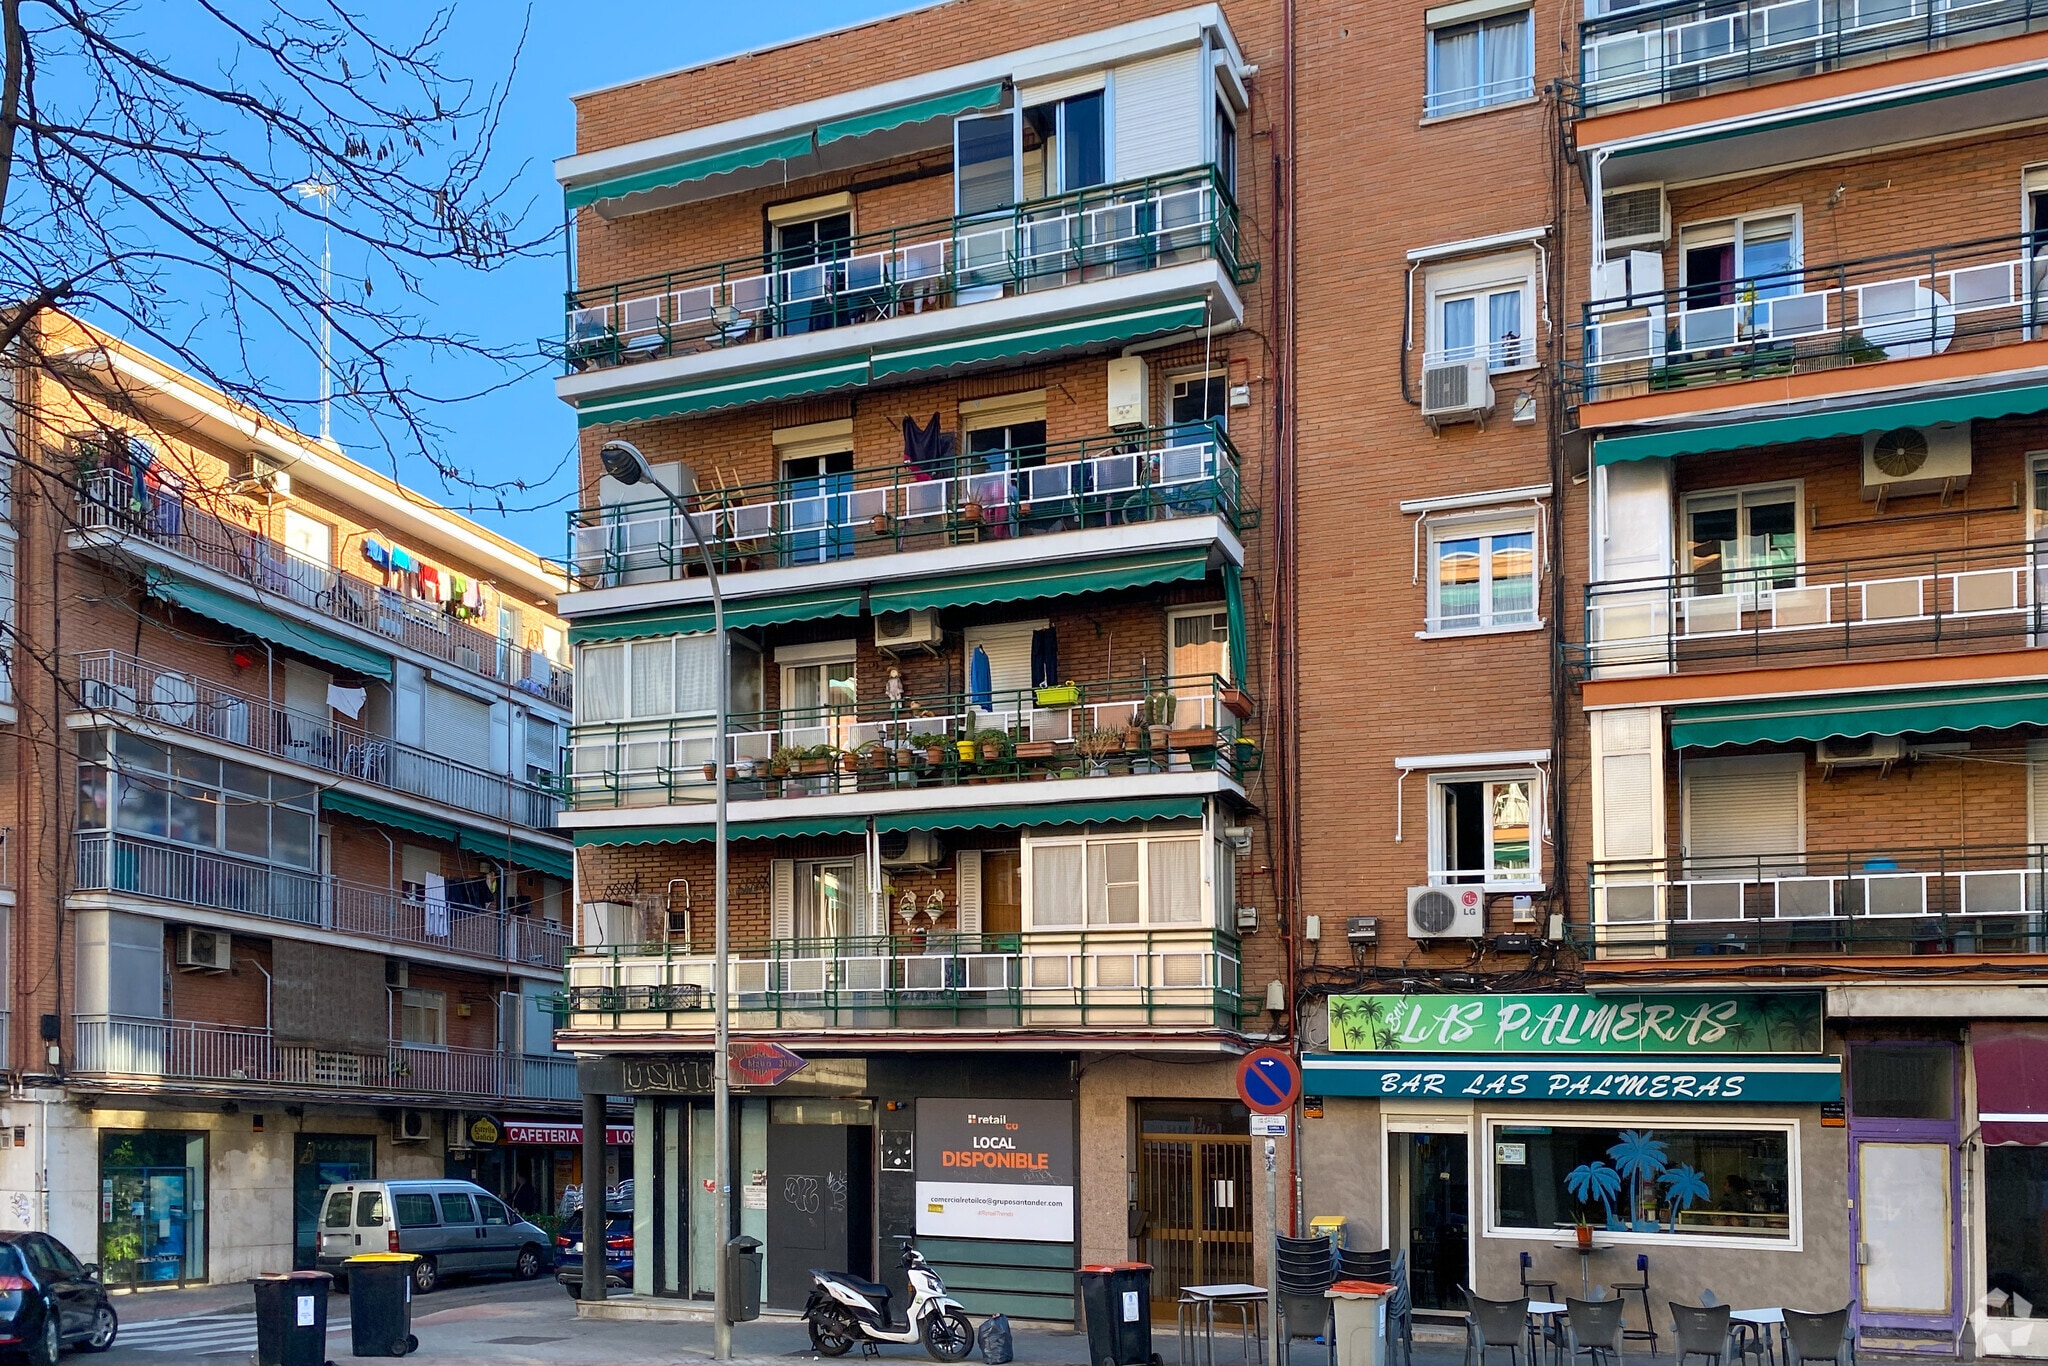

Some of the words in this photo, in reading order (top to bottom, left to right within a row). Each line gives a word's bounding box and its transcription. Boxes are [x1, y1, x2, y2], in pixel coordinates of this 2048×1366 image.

[1463, 908, 1476, 916] LG
[1400, 1001, 1487, 1045] LAS
[1494, 1000, 1742, 1046] PALMERAS
[1381, 1073, 1446, 1094] BAR
[1462, 1074, 1529, 1095] LAS
[1548, 1074, 1746, 1098] PALMERAS
[978, 1114, 1007, 1125] retail
[510, 1127, 579, 1143] CAFETERIA
[973, 1136, 1016, 1149] LOCAL
[942, 1151, 1048, 1169] DISPONIBLE
[930, 1196, 1063, 1207] comercialretailco@gruposantander.com
